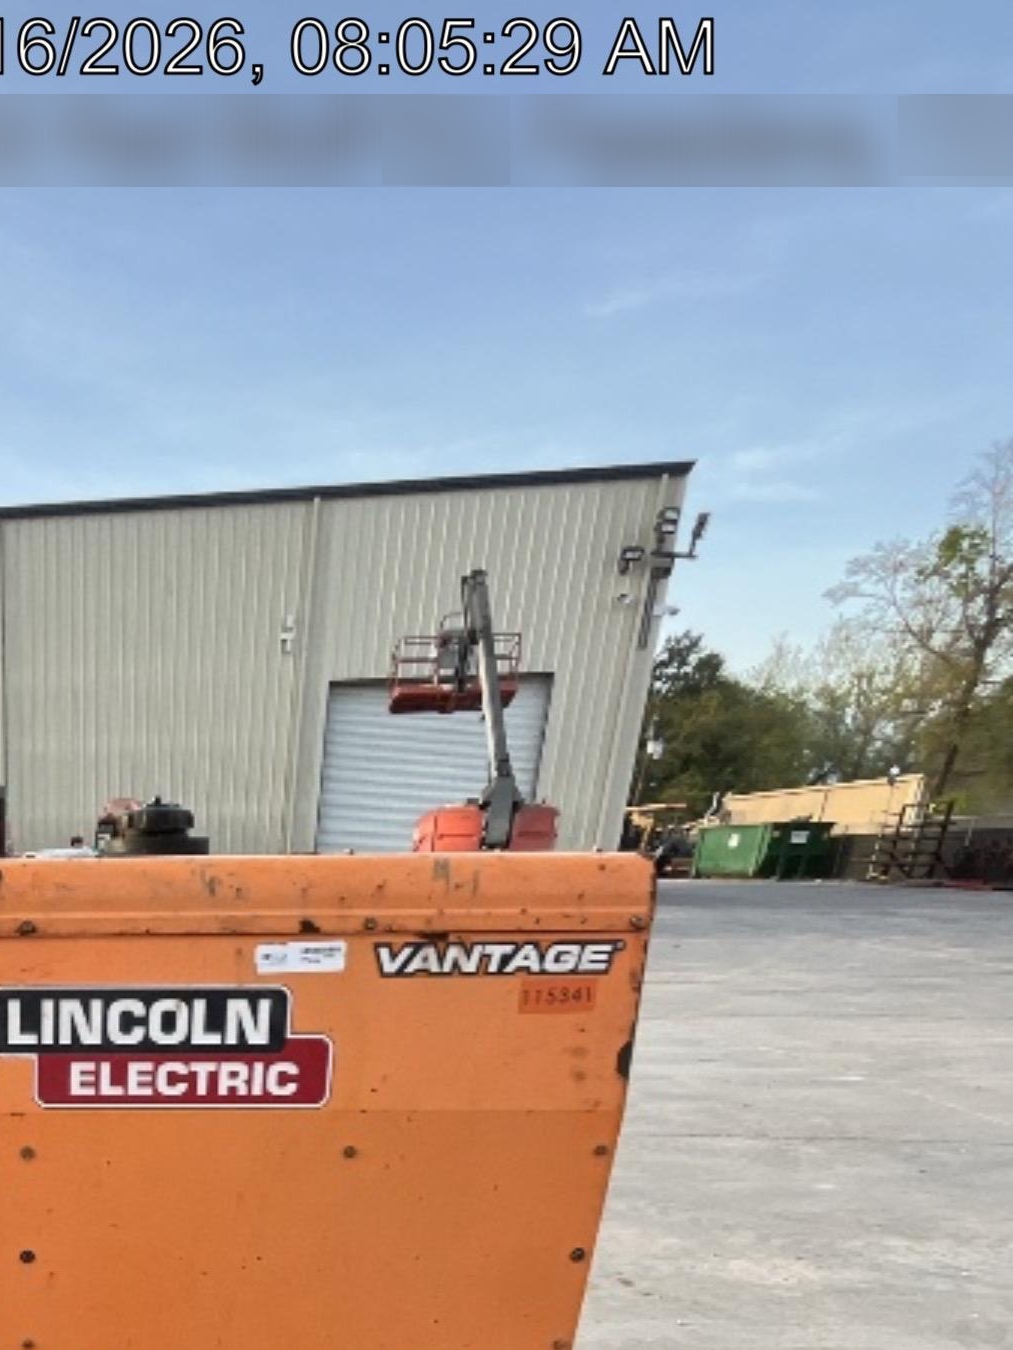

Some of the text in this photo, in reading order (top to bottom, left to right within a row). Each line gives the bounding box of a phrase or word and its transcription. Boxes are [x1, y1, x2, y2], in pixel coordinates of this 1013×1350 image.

[376, 943, 616, 974] VANTAGE
[6, 998, 273, 1045] LINCOLN
[69, 1061, 300, 1097] ELECTRIC
